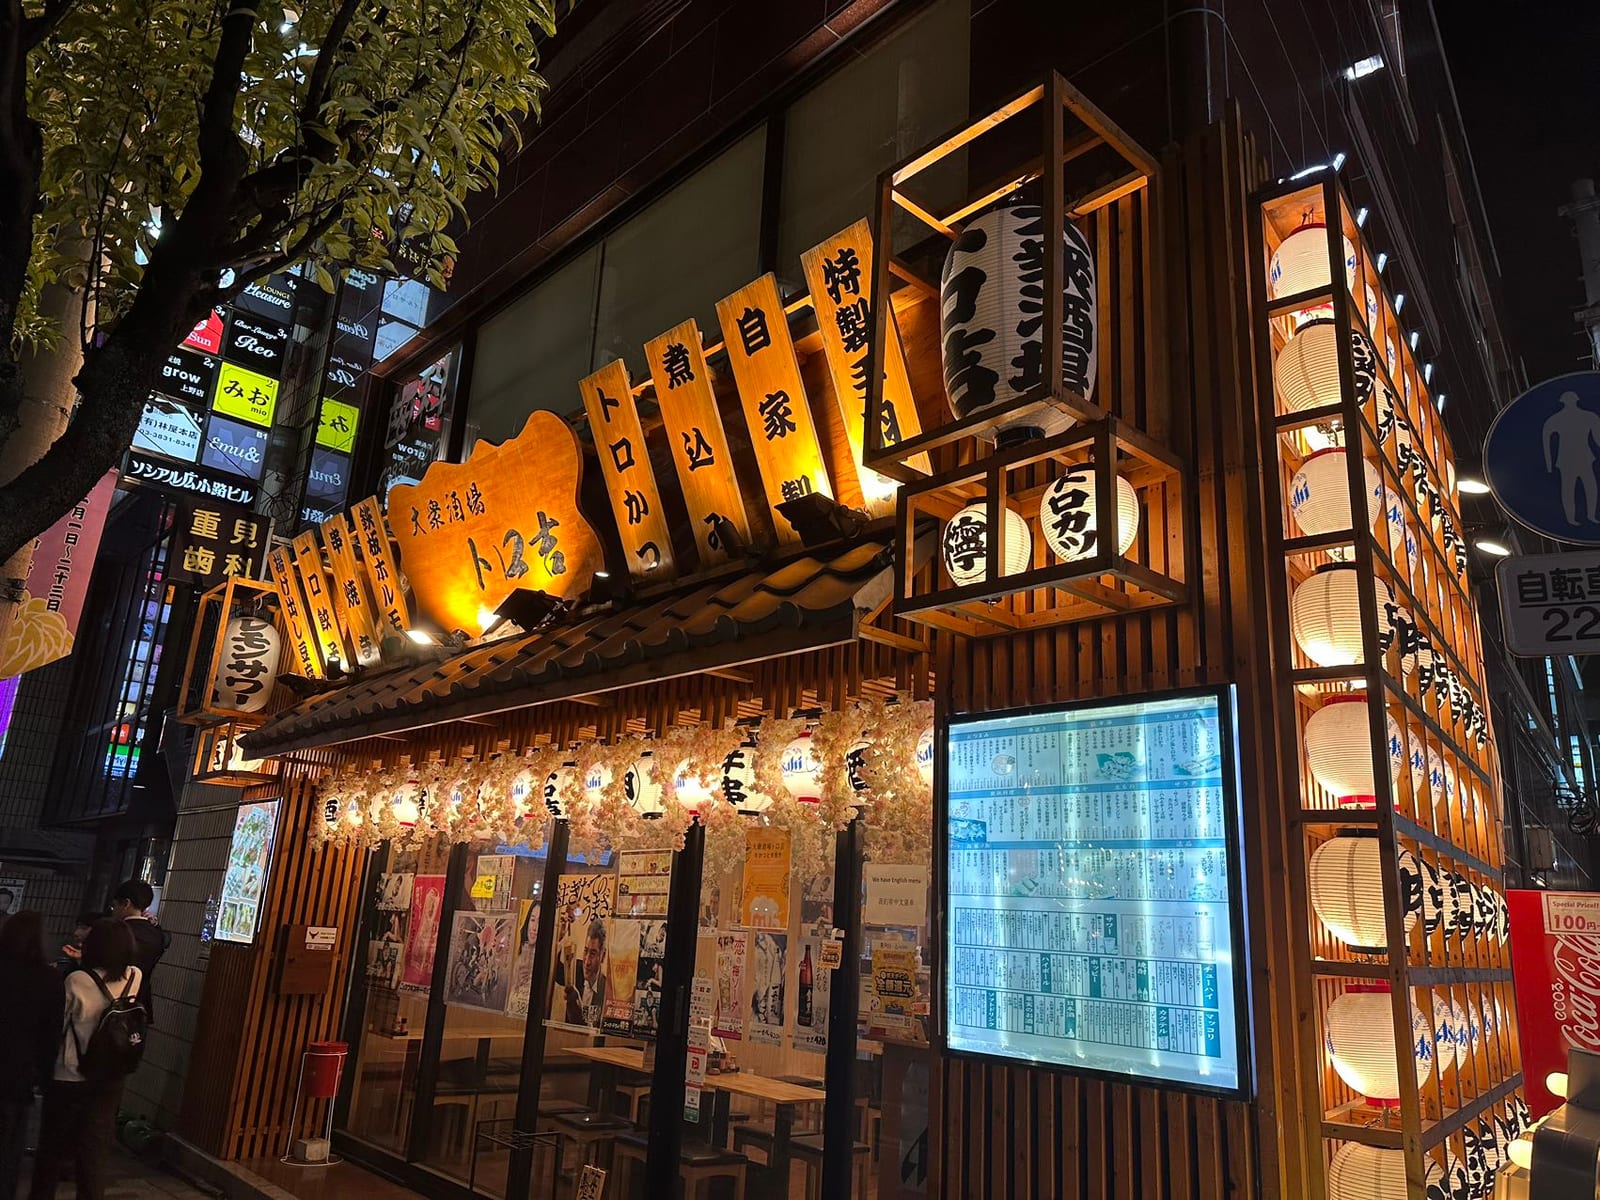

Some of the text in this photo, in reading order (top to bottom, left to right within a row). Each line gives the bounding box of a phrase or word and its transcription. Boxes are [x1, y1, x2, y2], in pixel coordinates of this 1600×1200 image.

[263, 285, 290, 300] LOUNGE
[162, 364, 201, 384] grow
[223, 380, 270, 406] みお
[250, 407, 267, 416] mio
[131, 460, 253, 503] ソシアル広小路ビル
[596, 387, 662, 572] トロかつ
[411, 482, 485, 537] 大衆酒場
